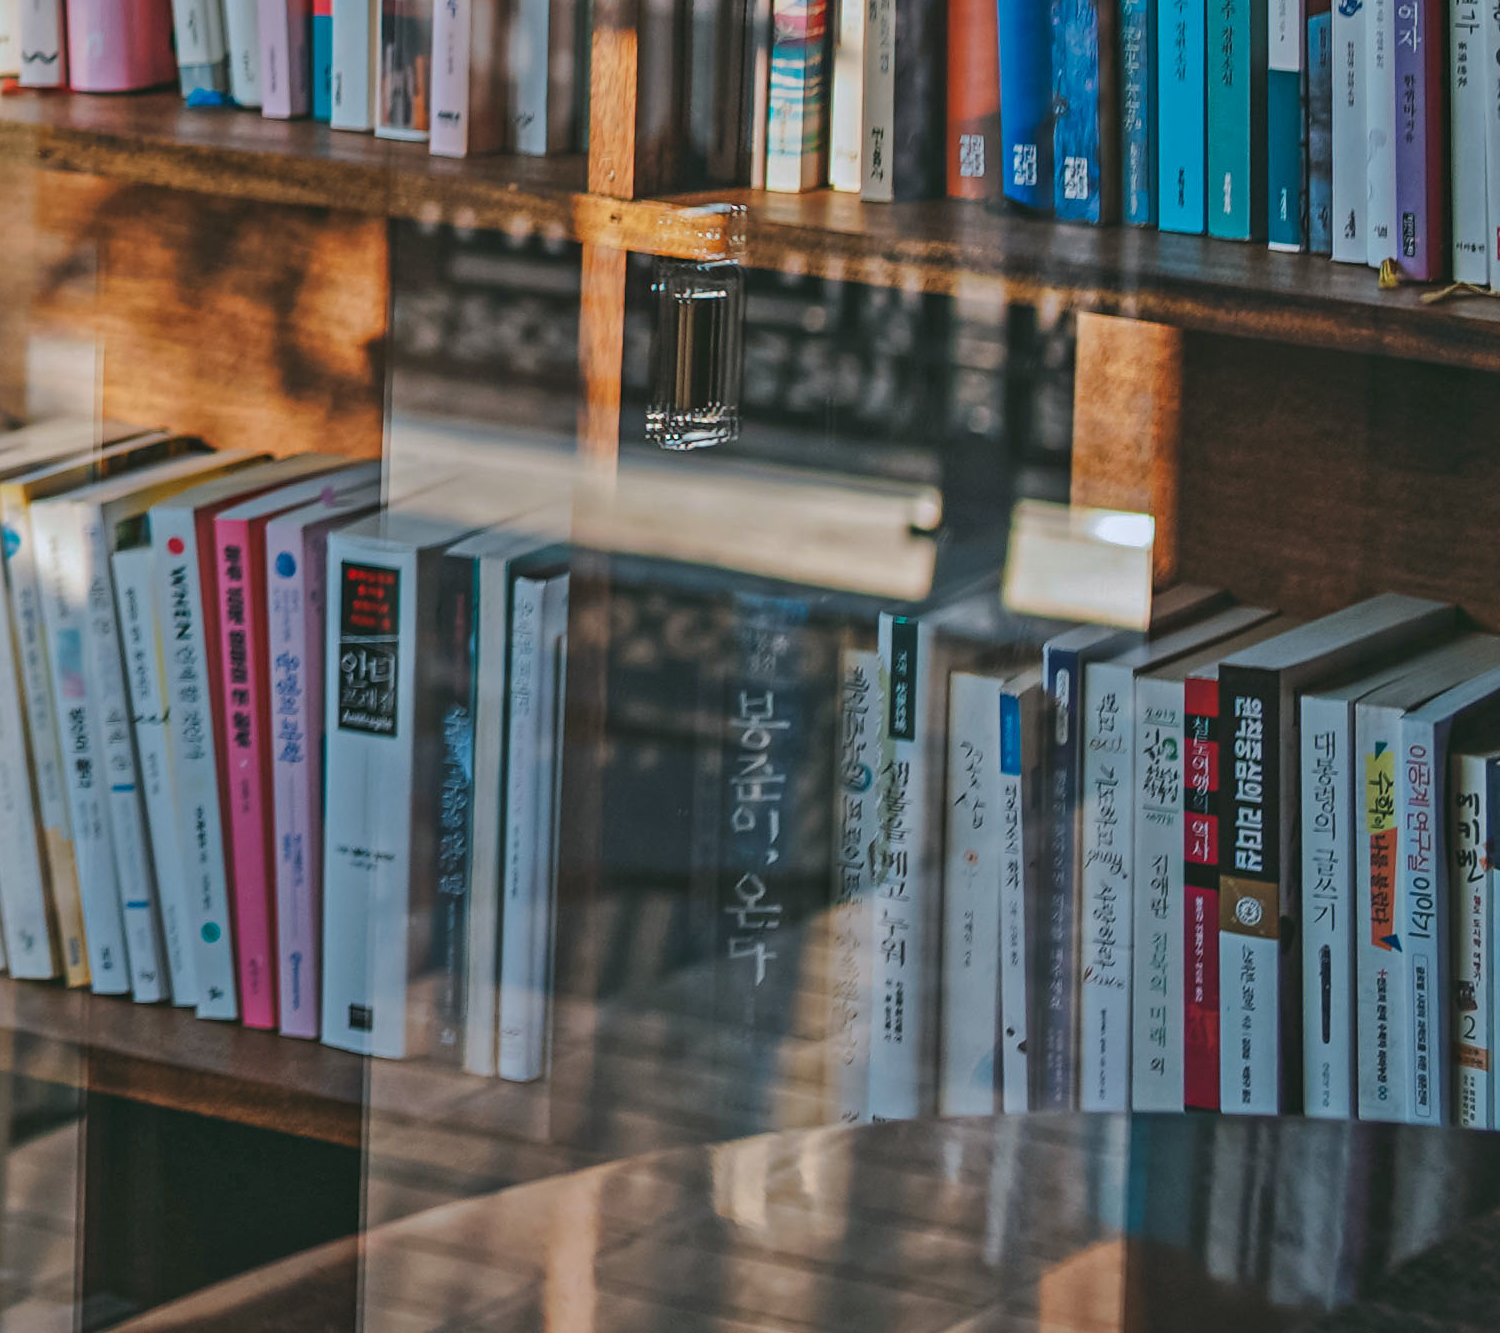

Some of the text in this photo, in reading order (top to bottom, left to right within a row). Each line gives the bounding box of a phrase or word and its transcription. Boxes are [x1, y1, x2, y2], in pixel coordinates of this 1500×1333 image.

[1397, 1, 1421, 54] 여자
[1234, 695, 1263, 873] 원칙중심의 리더십
[1368, 769, 1395, 830] 수학이
[1191, 820, 1210, 862] 역사
[1312, 730, 1339, 932] 대통령의 글쓰기
[1406, 744, 1435, 939] 이공계 연구실 이야기
[1456, 792, 1486, 883] 에키벤
[723, 871, 784, 987] 온다
[876, 908, 910, 968] 누워
[1148, 1004, 1169, 1049] 미래
[1463, 1014, 1477, 1041] 2
